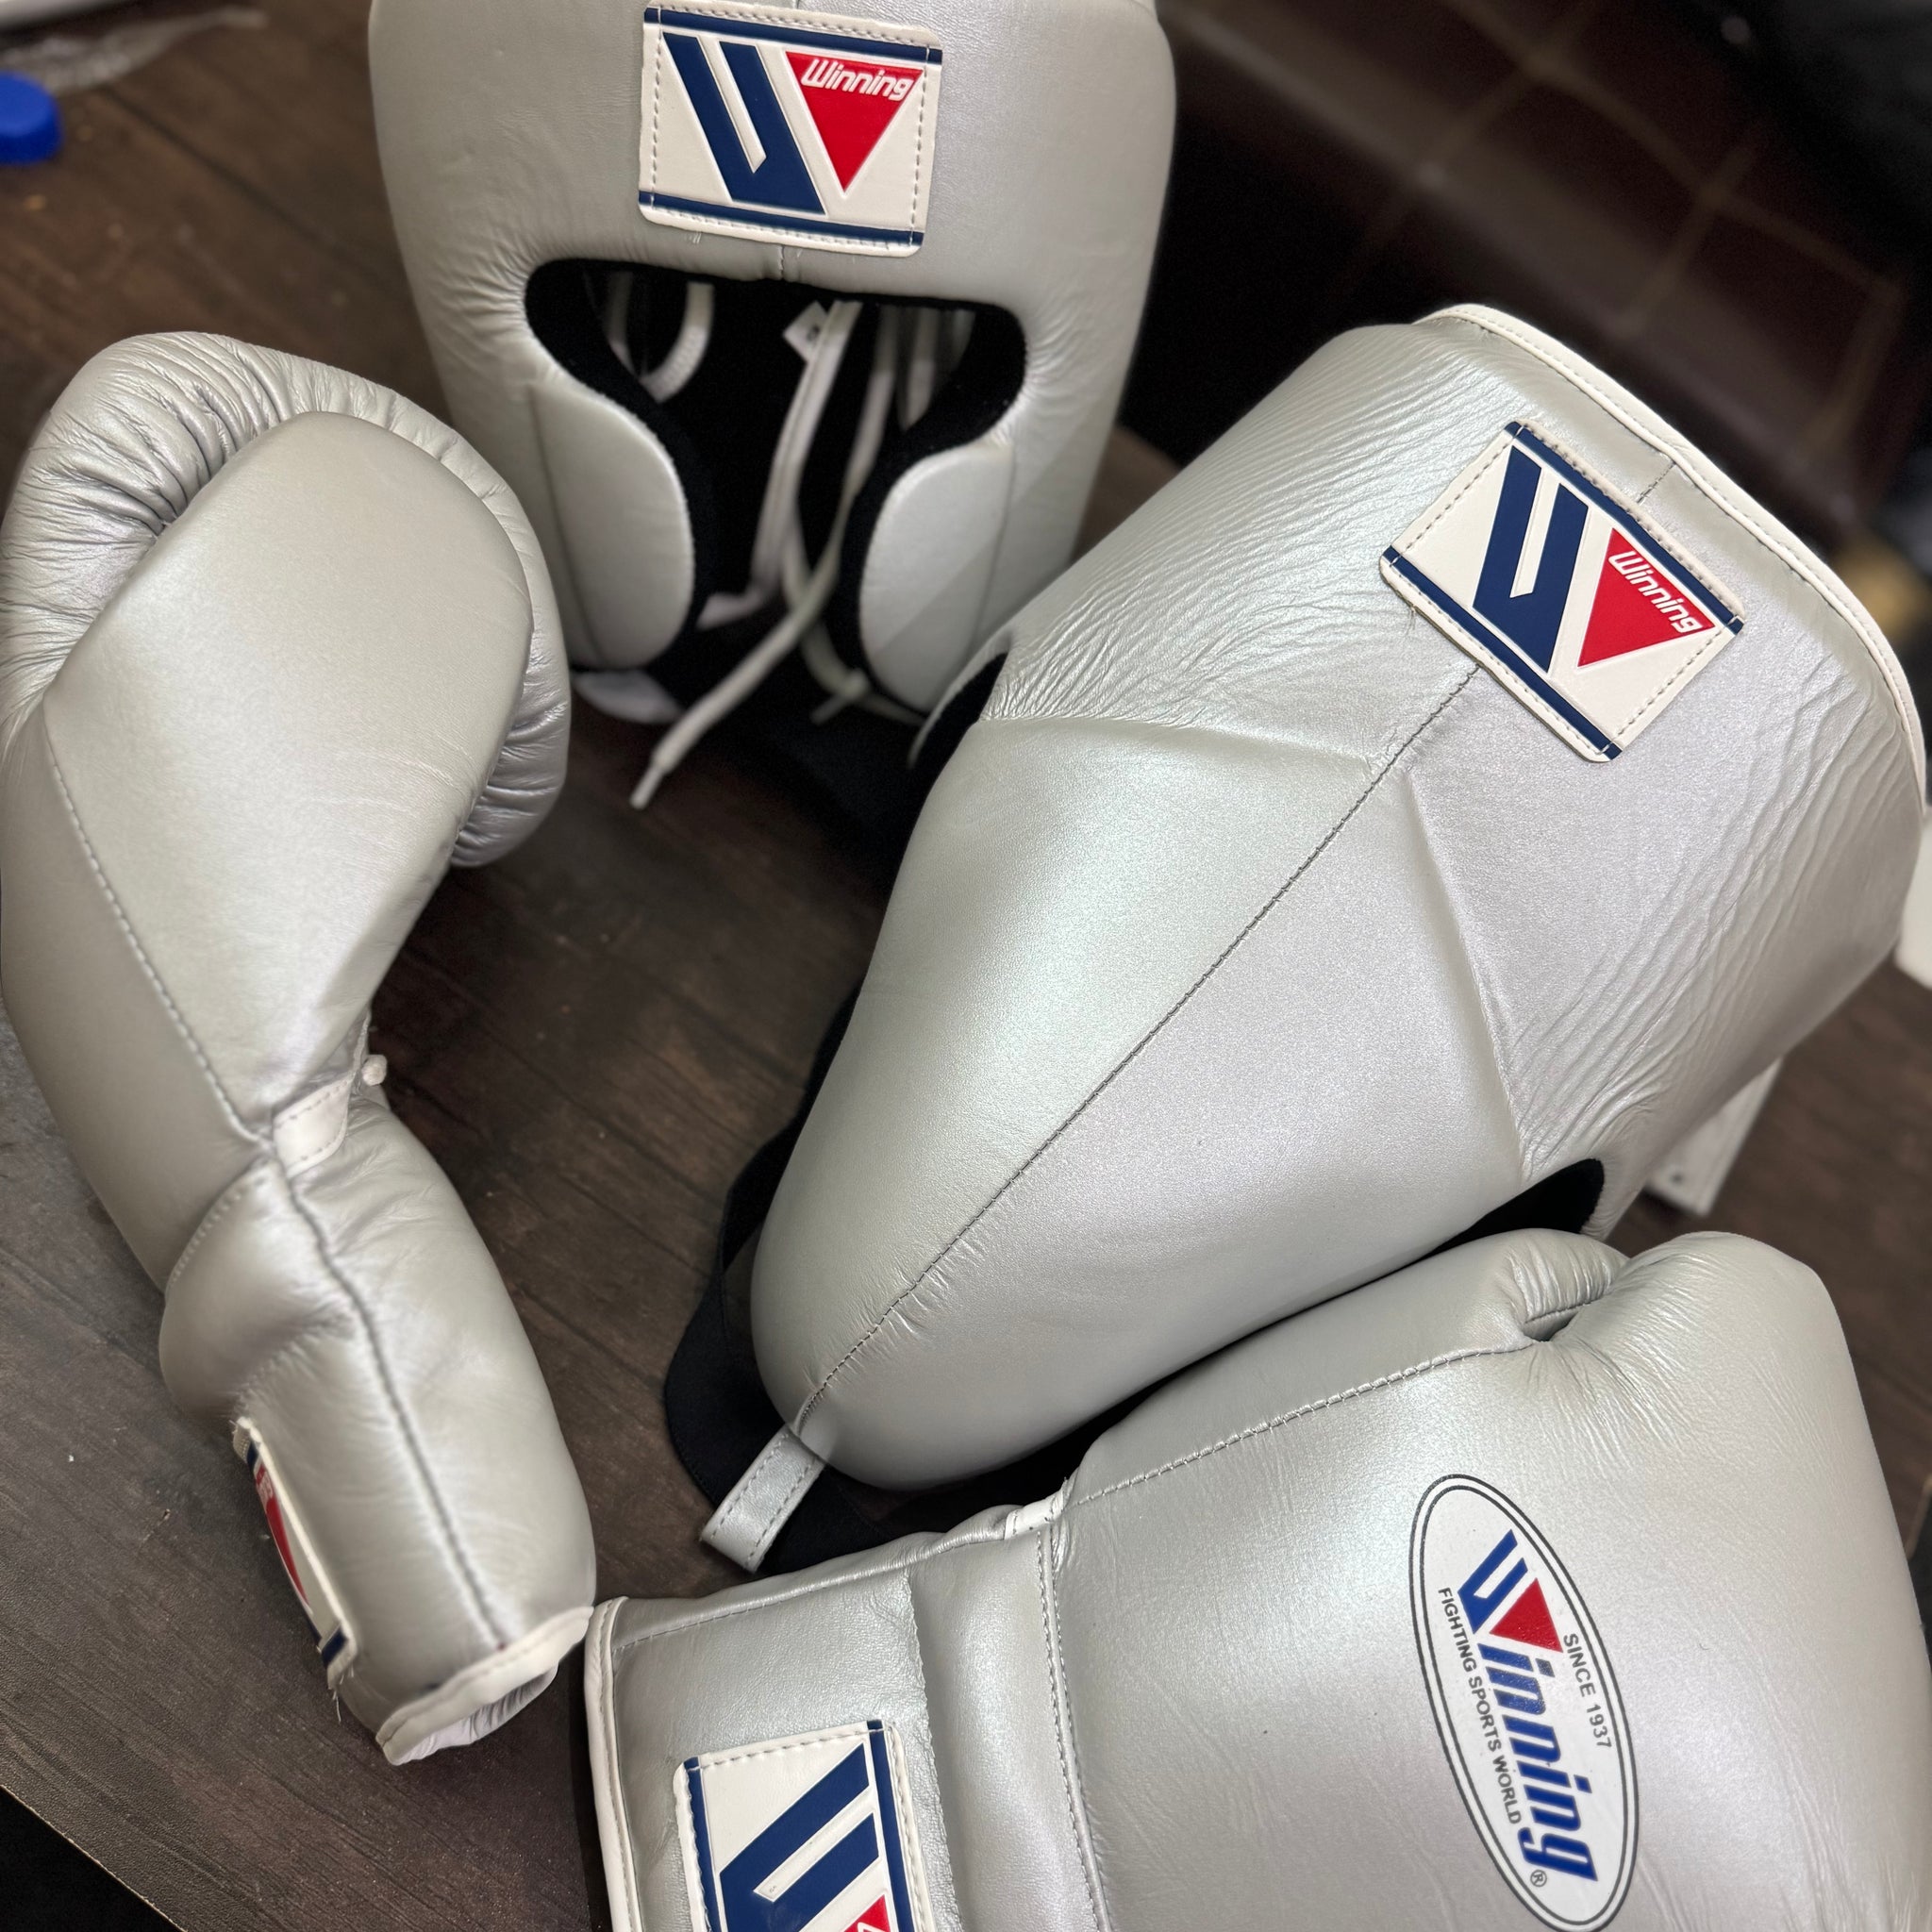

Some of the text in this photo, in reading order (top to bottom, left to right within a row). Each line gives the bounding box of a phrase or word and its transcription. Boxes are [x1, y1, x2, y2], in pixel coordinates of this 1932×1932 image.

[801, 58, 915, 102] Winning
[1607, 550, 1704, 634] Winning
[1438, 1587, 1522, 1824] FIGHTING SPORTS WORLD
[1563, 1633, 1612, 1748] SINCE 1937
